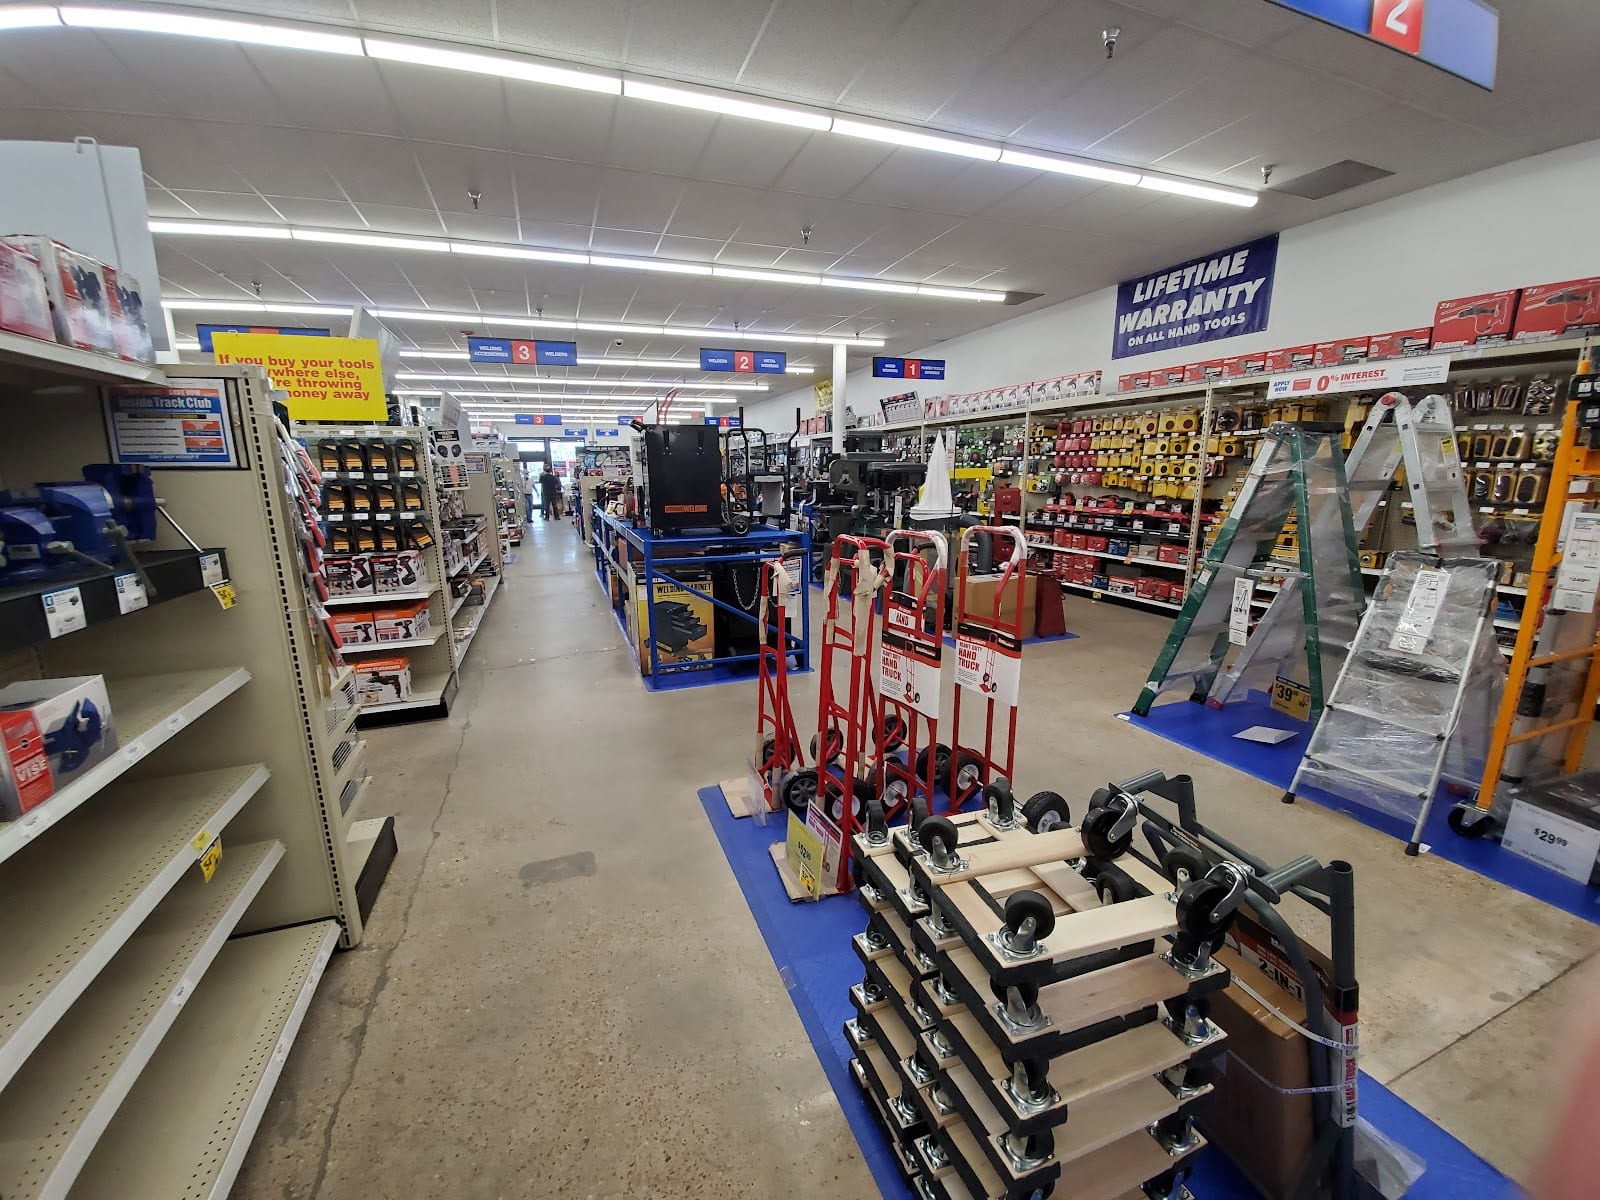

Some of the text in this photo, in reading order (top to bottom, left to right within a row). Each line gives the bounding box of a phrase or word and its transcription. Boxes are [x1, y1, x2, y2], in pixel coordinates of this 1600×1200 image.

[1132, 249, 1250, 304] LIFETIME
[1118, 277, 1267, 335] WARRANTY
[1128, 312, 1246, 347] ON ALL HAND TOOLS
[518, 345, 530, 360] 3
[218, 354, 374, 369] If you buy your tools
[740, 356, 749, 369] 2
[268, 368, 359, 380] ywhere else,
[909, 364, 915, 375] 1
[1340, 369, 1386, 381] INTEREST
[272, 378, 362, 390] 're throwing
[155, 398, 185, 408] Track
[186, 397, 212, 408] Club
[333, 392, 370, 400] away
[958, 648, 977, 660] HAND
[882, 656, 898, 670] HAND
[958, 658, 980, 672] TRUCK
[882, 666, 902, 681] TRUCK
[15, 760, 48, 781] VISE
[1259, 957, 1302, 1000] 2-IN-1
